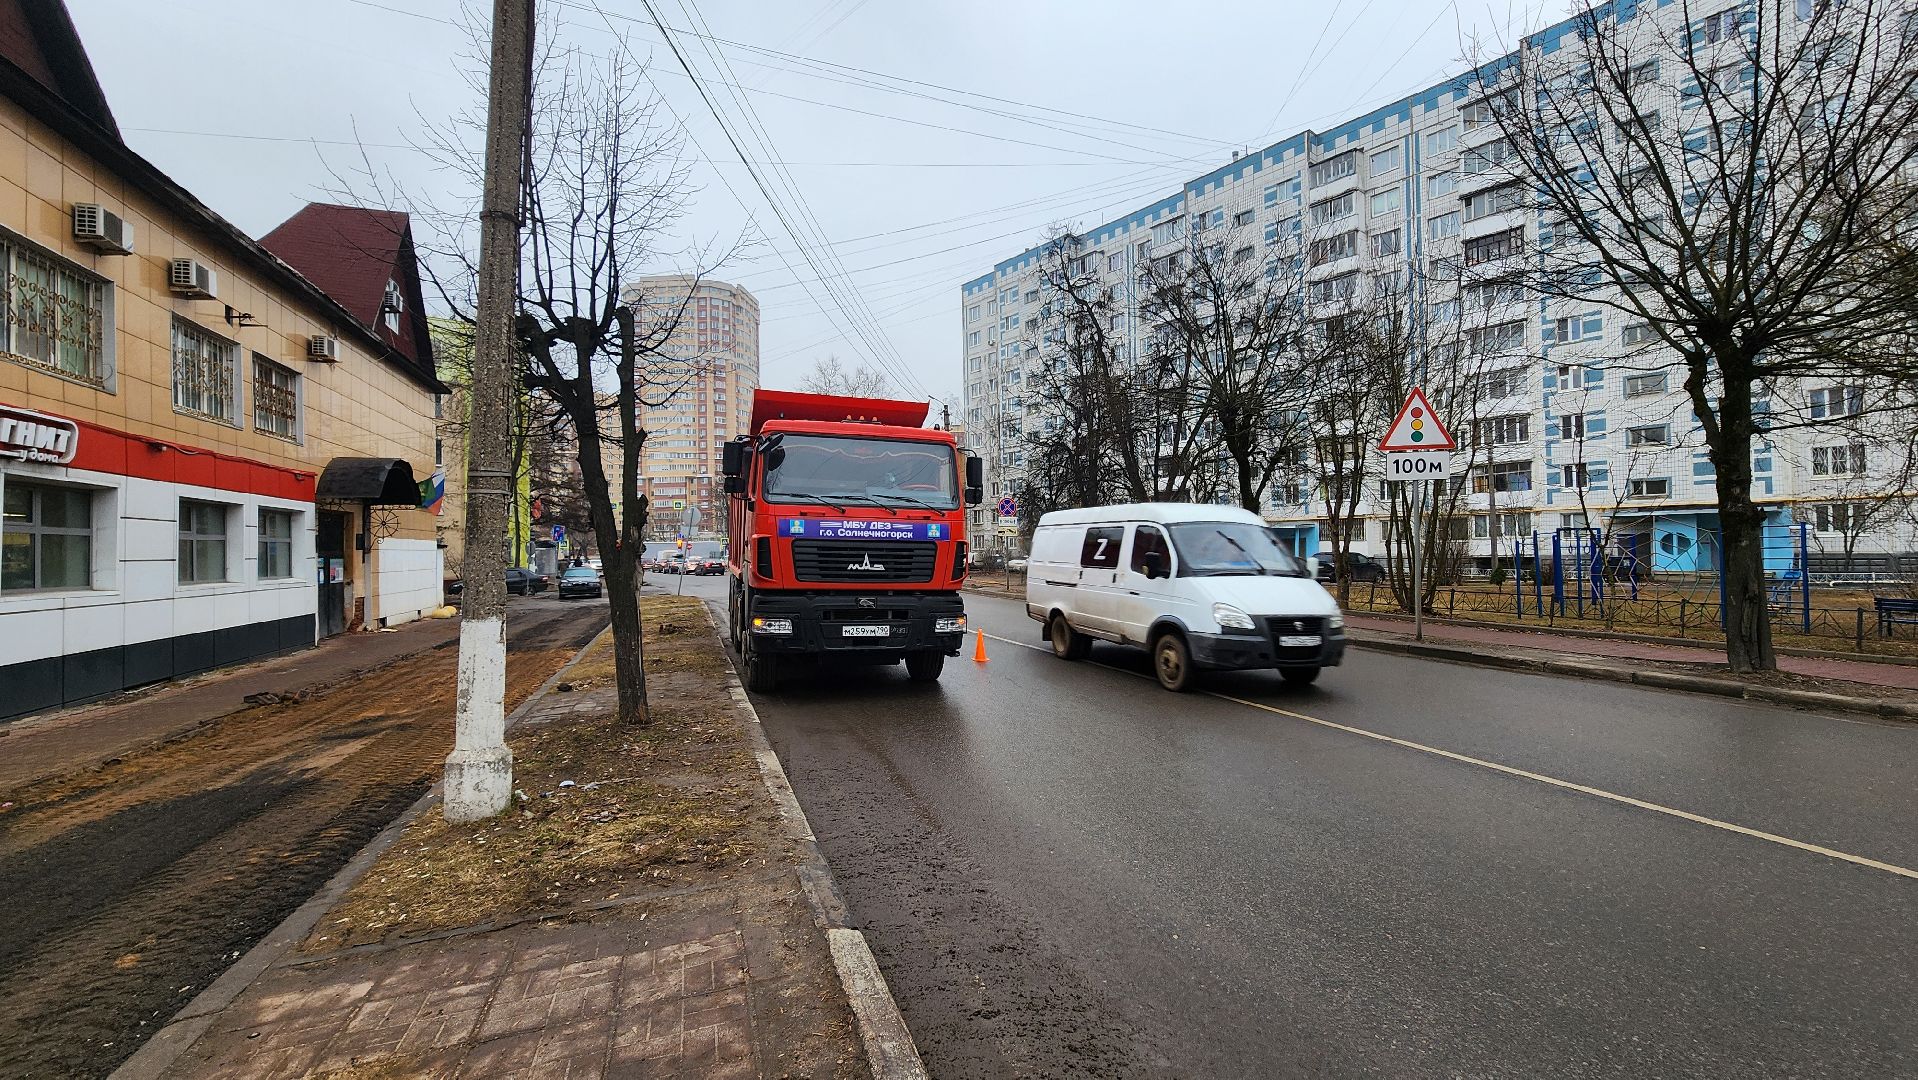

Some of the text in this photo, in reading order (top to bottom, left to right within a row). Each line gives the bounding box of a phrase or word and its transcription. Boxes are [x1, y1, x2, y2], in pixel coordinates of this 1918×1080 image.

[28, 448, 59, 463] дома
[843, 521, 892, 530] МБУ ДЕЗ
[820, 528, 913, 539] г.о. Солнечногорск
[1093, 538, 1108, 560] Z
